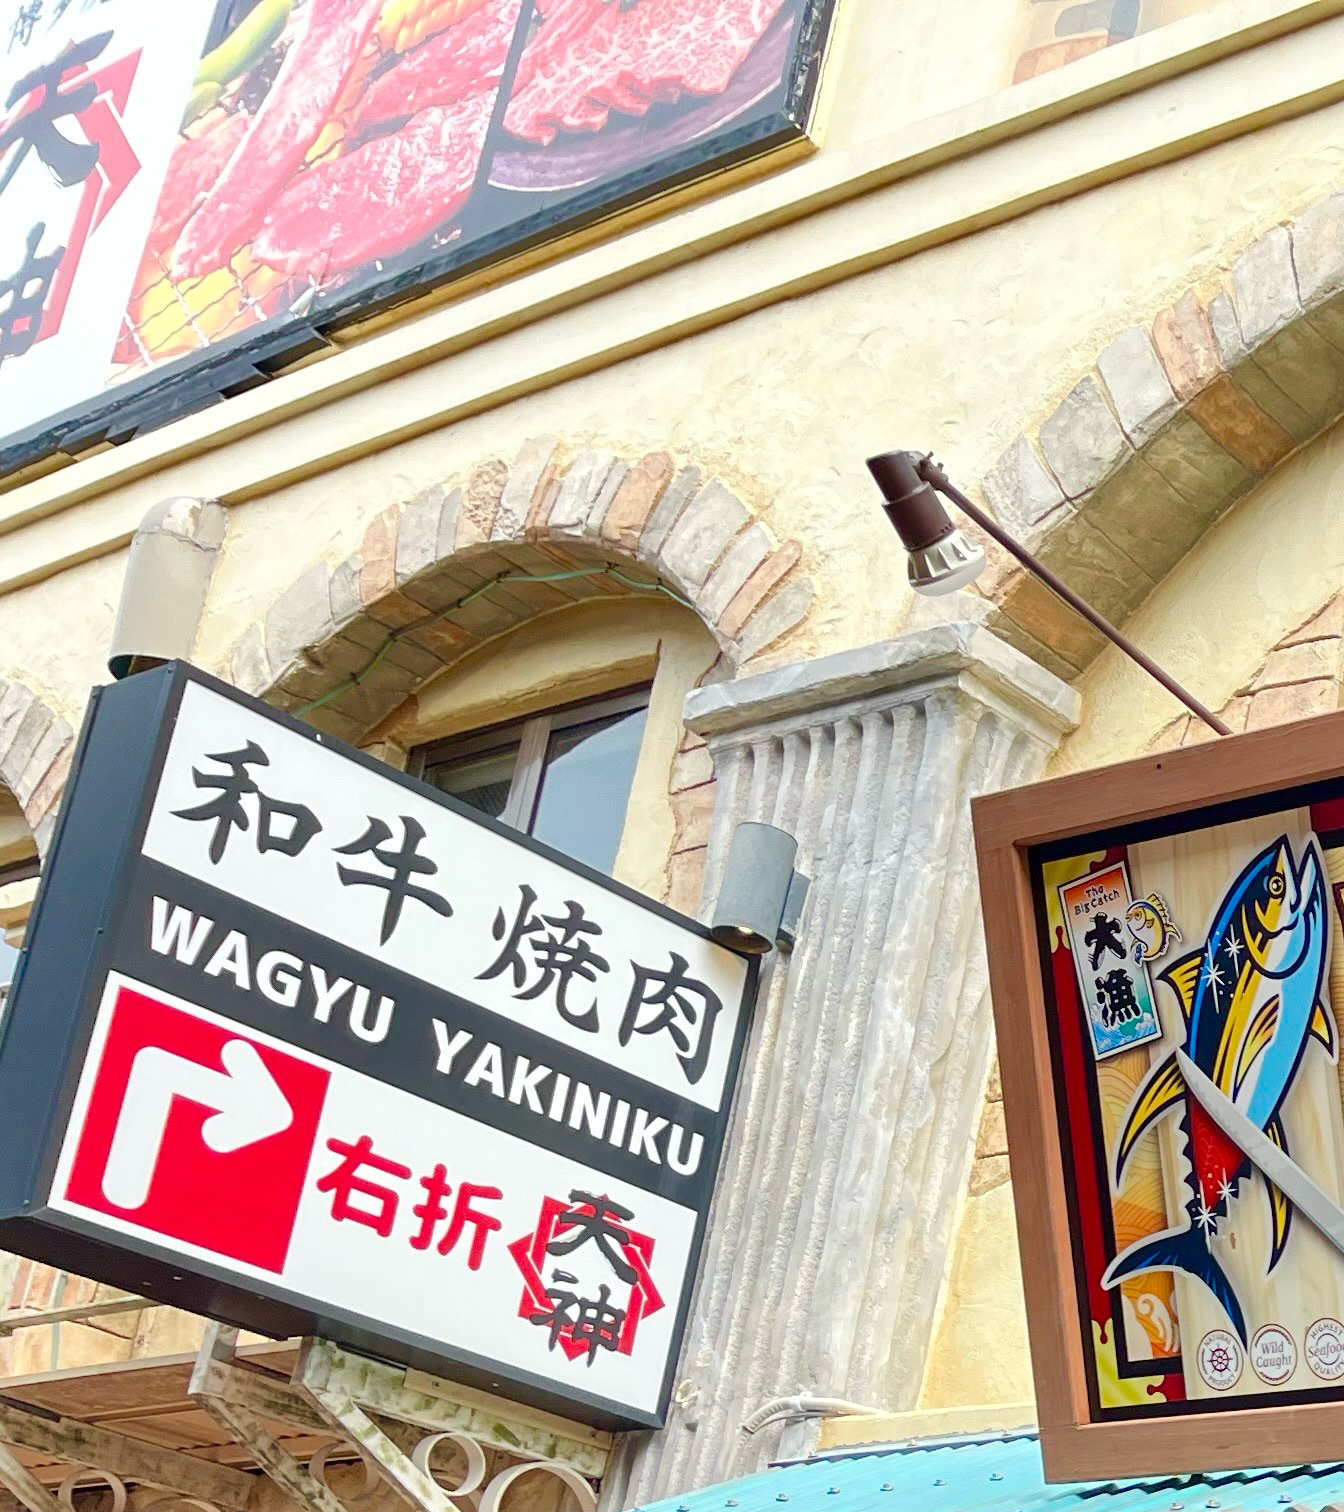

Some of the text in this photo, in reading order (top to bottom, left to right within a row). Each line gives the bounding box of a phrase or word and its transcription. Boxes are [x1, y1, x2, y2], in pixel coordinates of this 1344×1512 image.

[170, 740, 723, 1086] 和牛焼肉
[150, 894, 705, 1177] WAGYU YAKINIKU
[316, 1136, 504, 1271] 右折
[529, 1188, 640, 1369] 天神
[1311, 1322, 1344, 1340] HIGHEST
[1256, 1354, 1293, 1370] Caught
[1261, 1341, 1284, 1354] Wild
